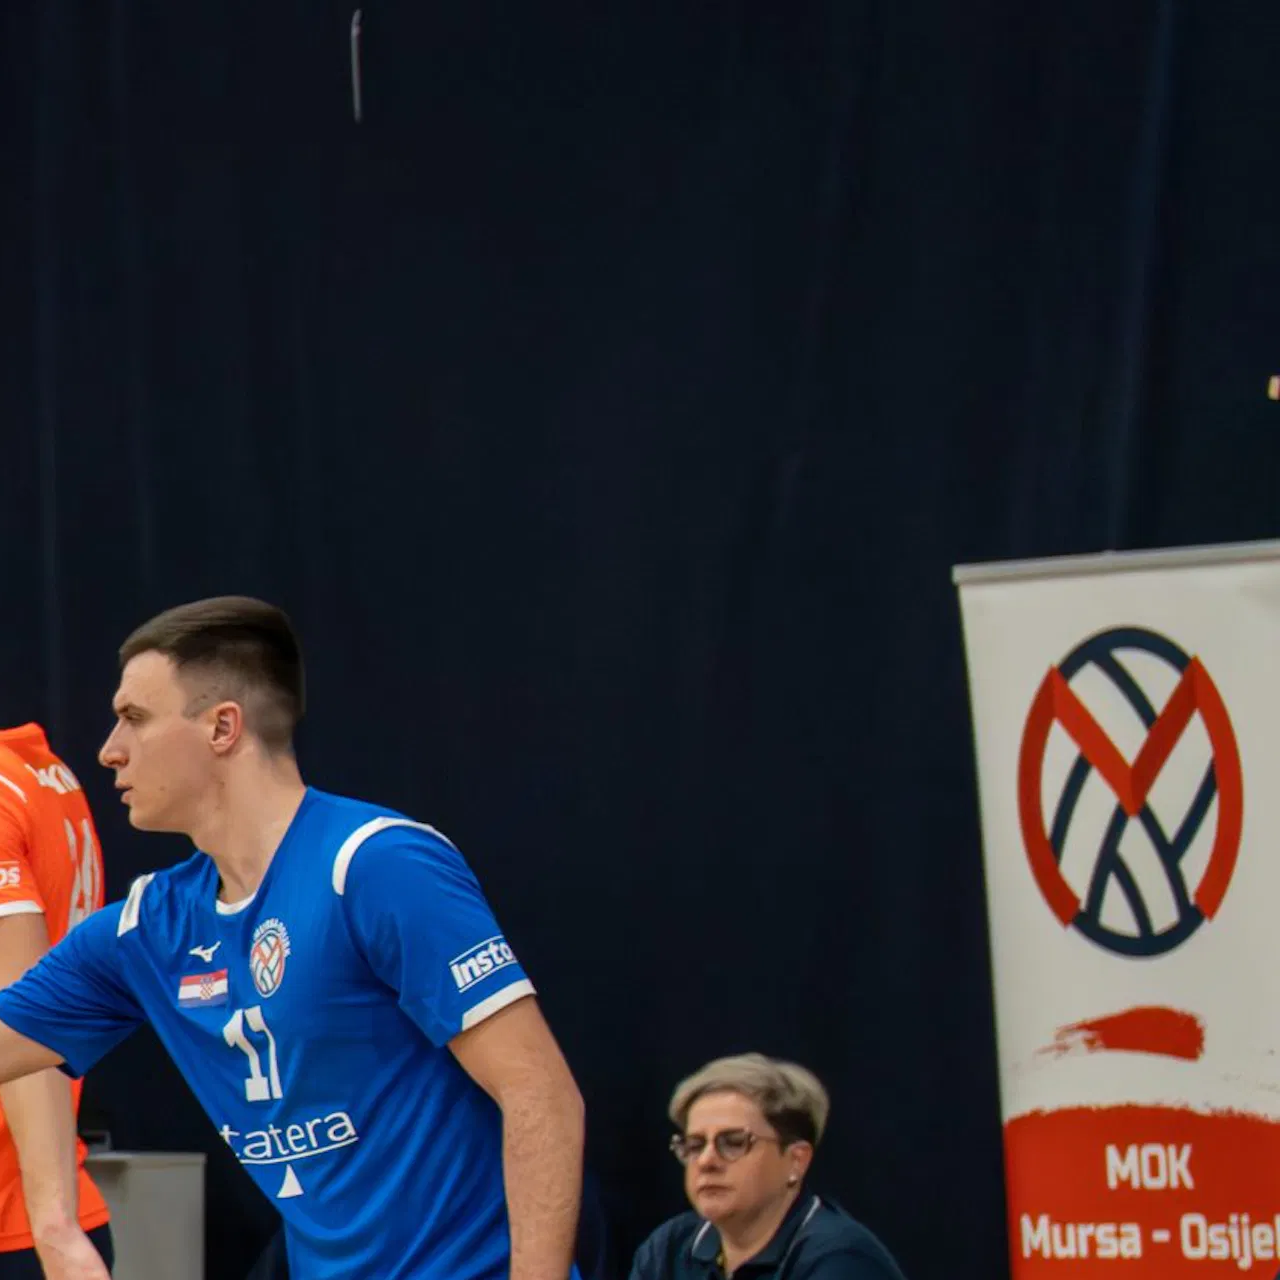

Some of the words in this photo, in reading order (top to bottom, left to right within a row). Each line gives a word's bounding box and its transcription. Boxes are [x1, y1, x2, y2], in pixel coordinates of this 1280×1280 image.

[450, 941, 517, 988] Insto
[1104, 1142, 1195, 1190] MOK
[1020, 1211, 1144, 1260] Mursa
